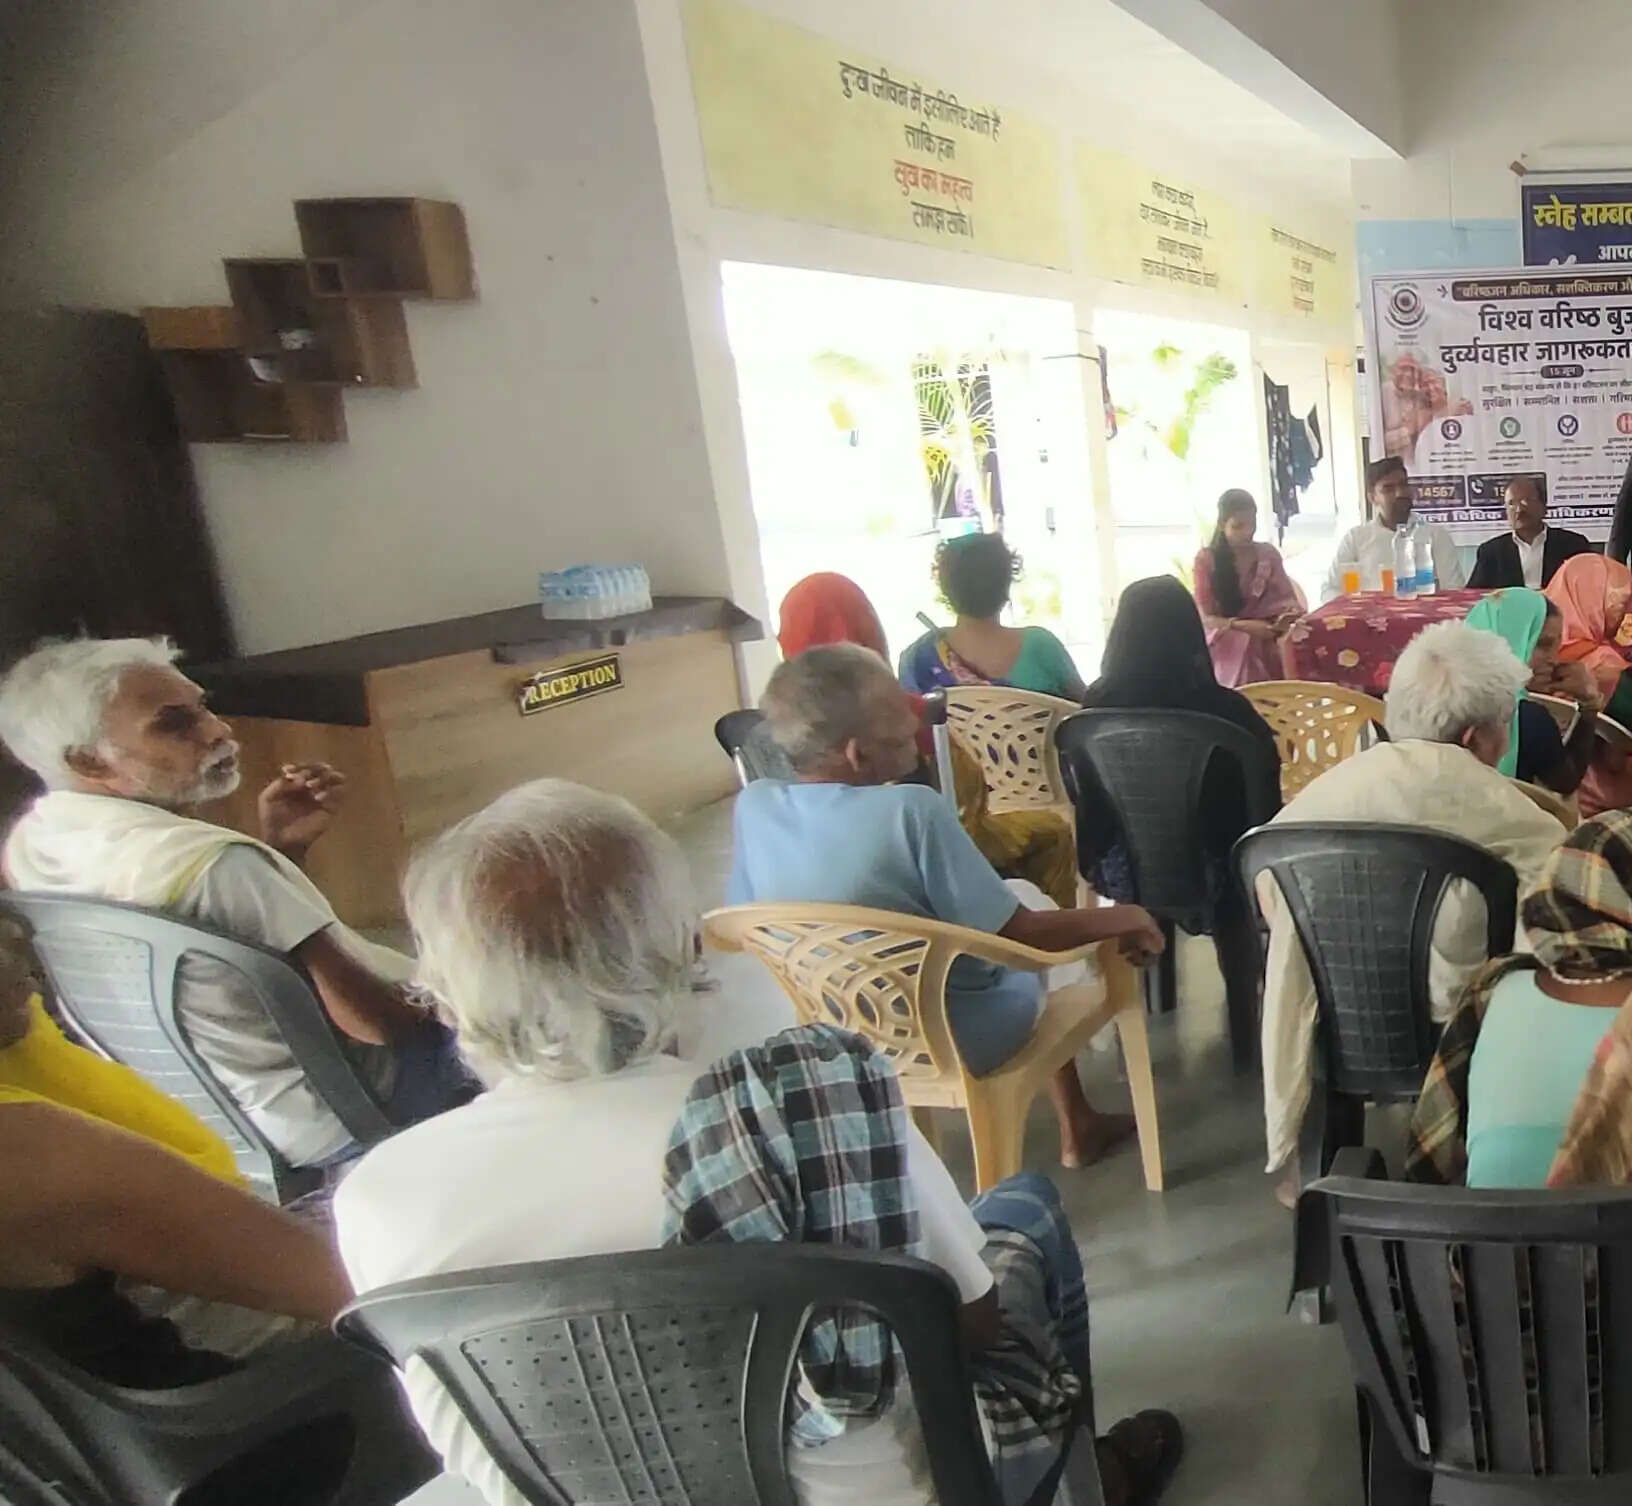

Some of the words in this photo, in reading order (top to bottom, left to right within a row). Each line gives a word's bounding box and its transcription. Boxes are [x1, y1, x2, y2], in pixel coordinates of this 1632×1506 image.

[871, 67, 908, 108] जीवन
[904, 122, 935, 154] ताकि
[893, 160, 919, 196] सुख
[1533, 194, 1577, 231] स्नेह
[1479, 303, 1533, 332] विश्व
[1539, 301, 1601, 330] वरिष्ठ
[1440, 337, 1530, 374] दुर्व्यवहार
[1417, 486, 1456, 498] 14567
[525, 664, 617, 704] RECEPTION
